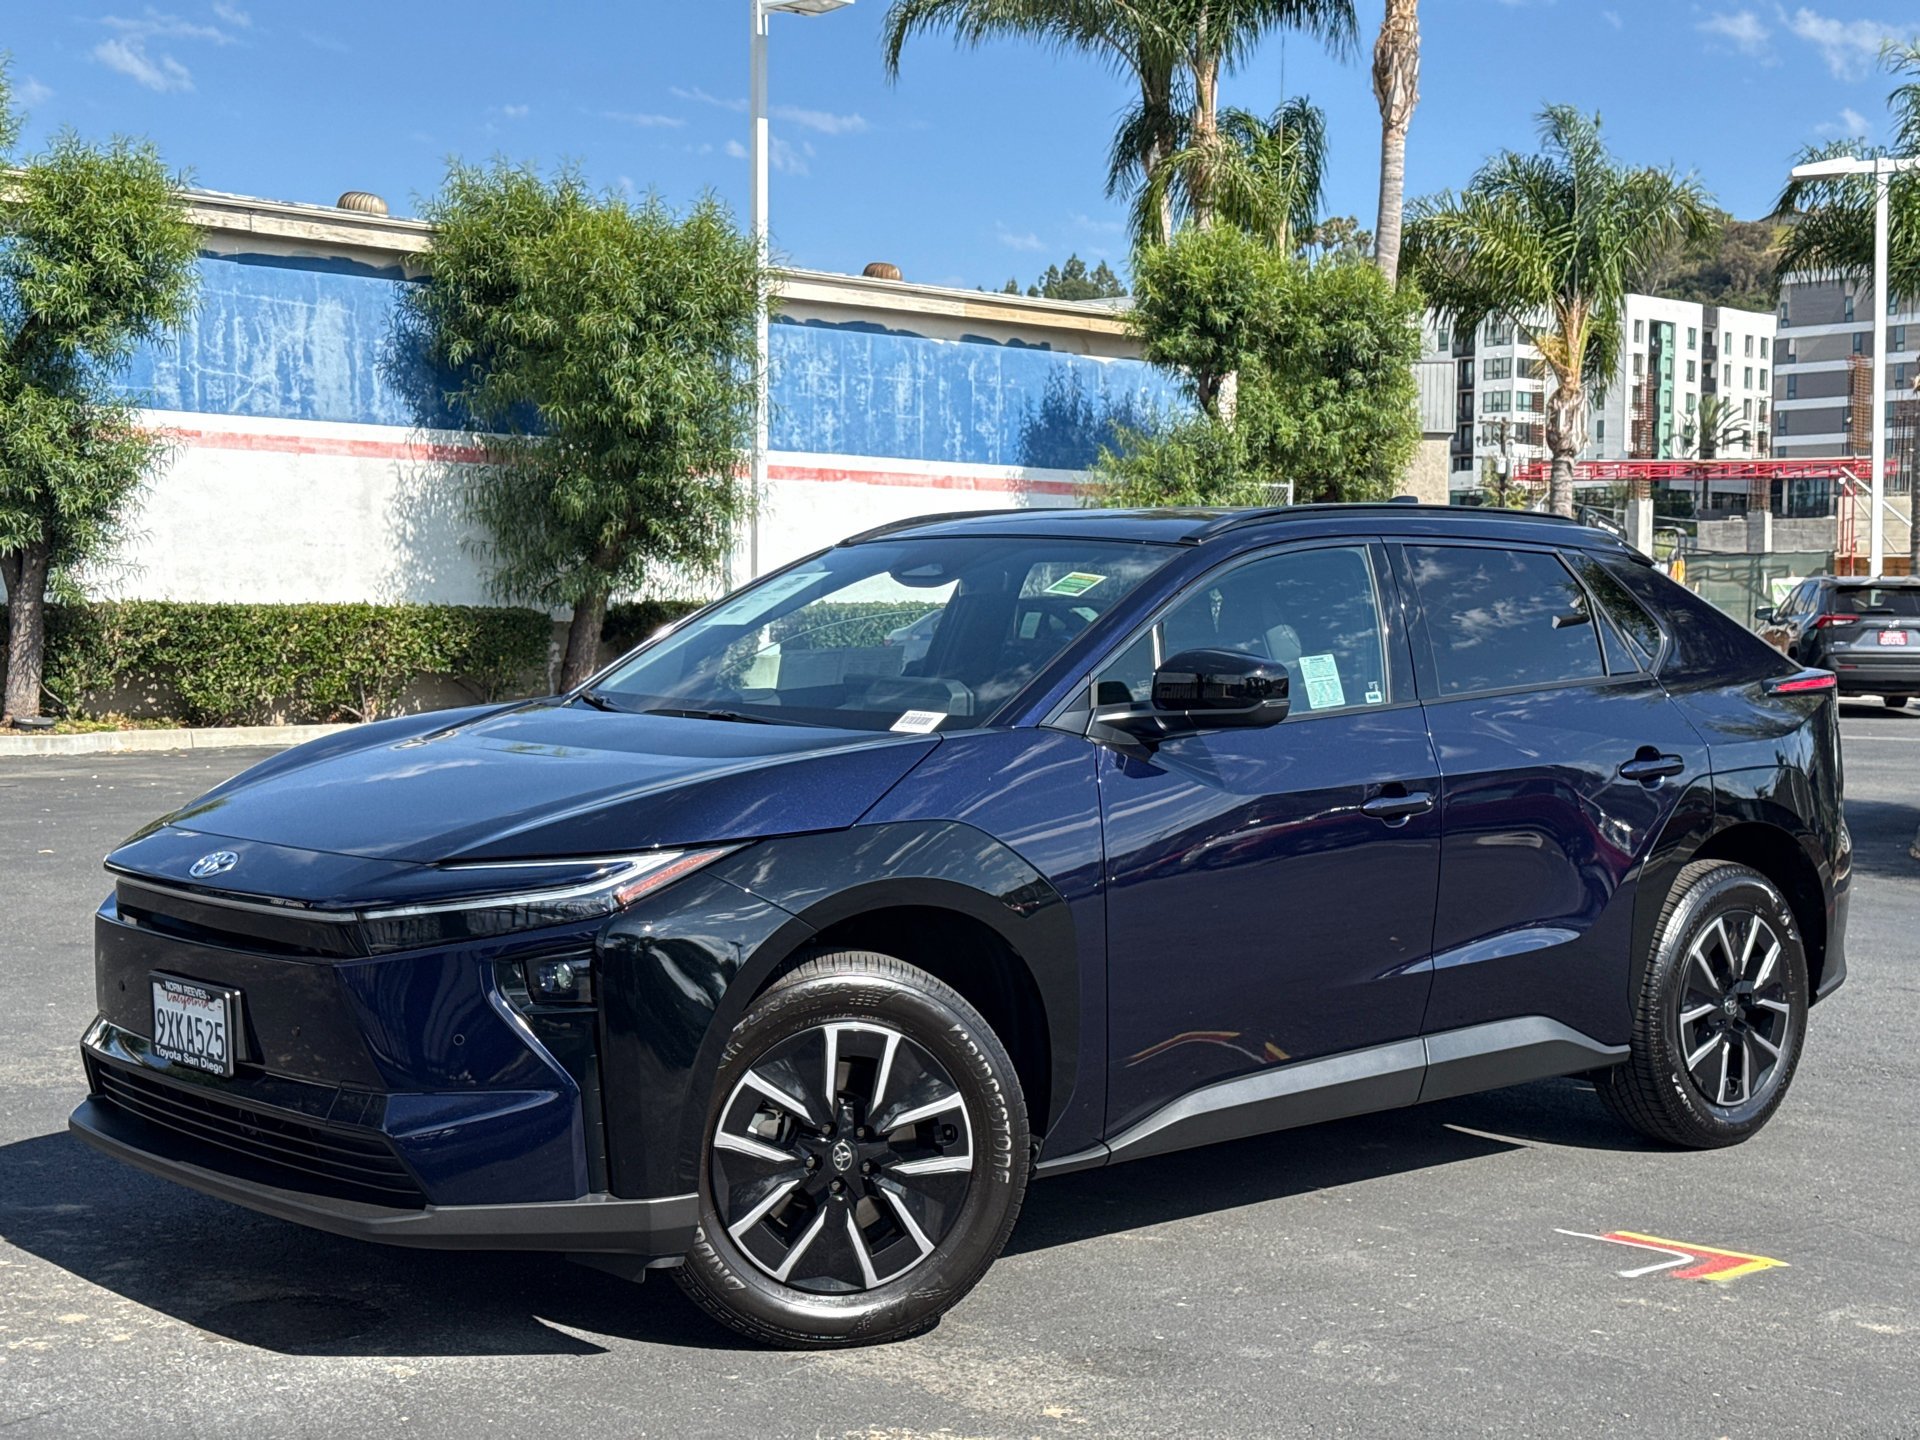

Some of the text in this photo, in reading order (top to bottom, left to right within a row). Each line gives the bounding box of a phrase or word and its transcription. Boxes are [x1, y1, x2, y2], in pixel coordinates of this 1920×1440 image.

[165, 980, 207, 999] NORM REEVES
[157, 1008, 225, 1060] 9XKA525
[155, 1045, 224, 1074] Toyota San Diego
[943, 1023, 1012, 1184] BRIDGESTONE
